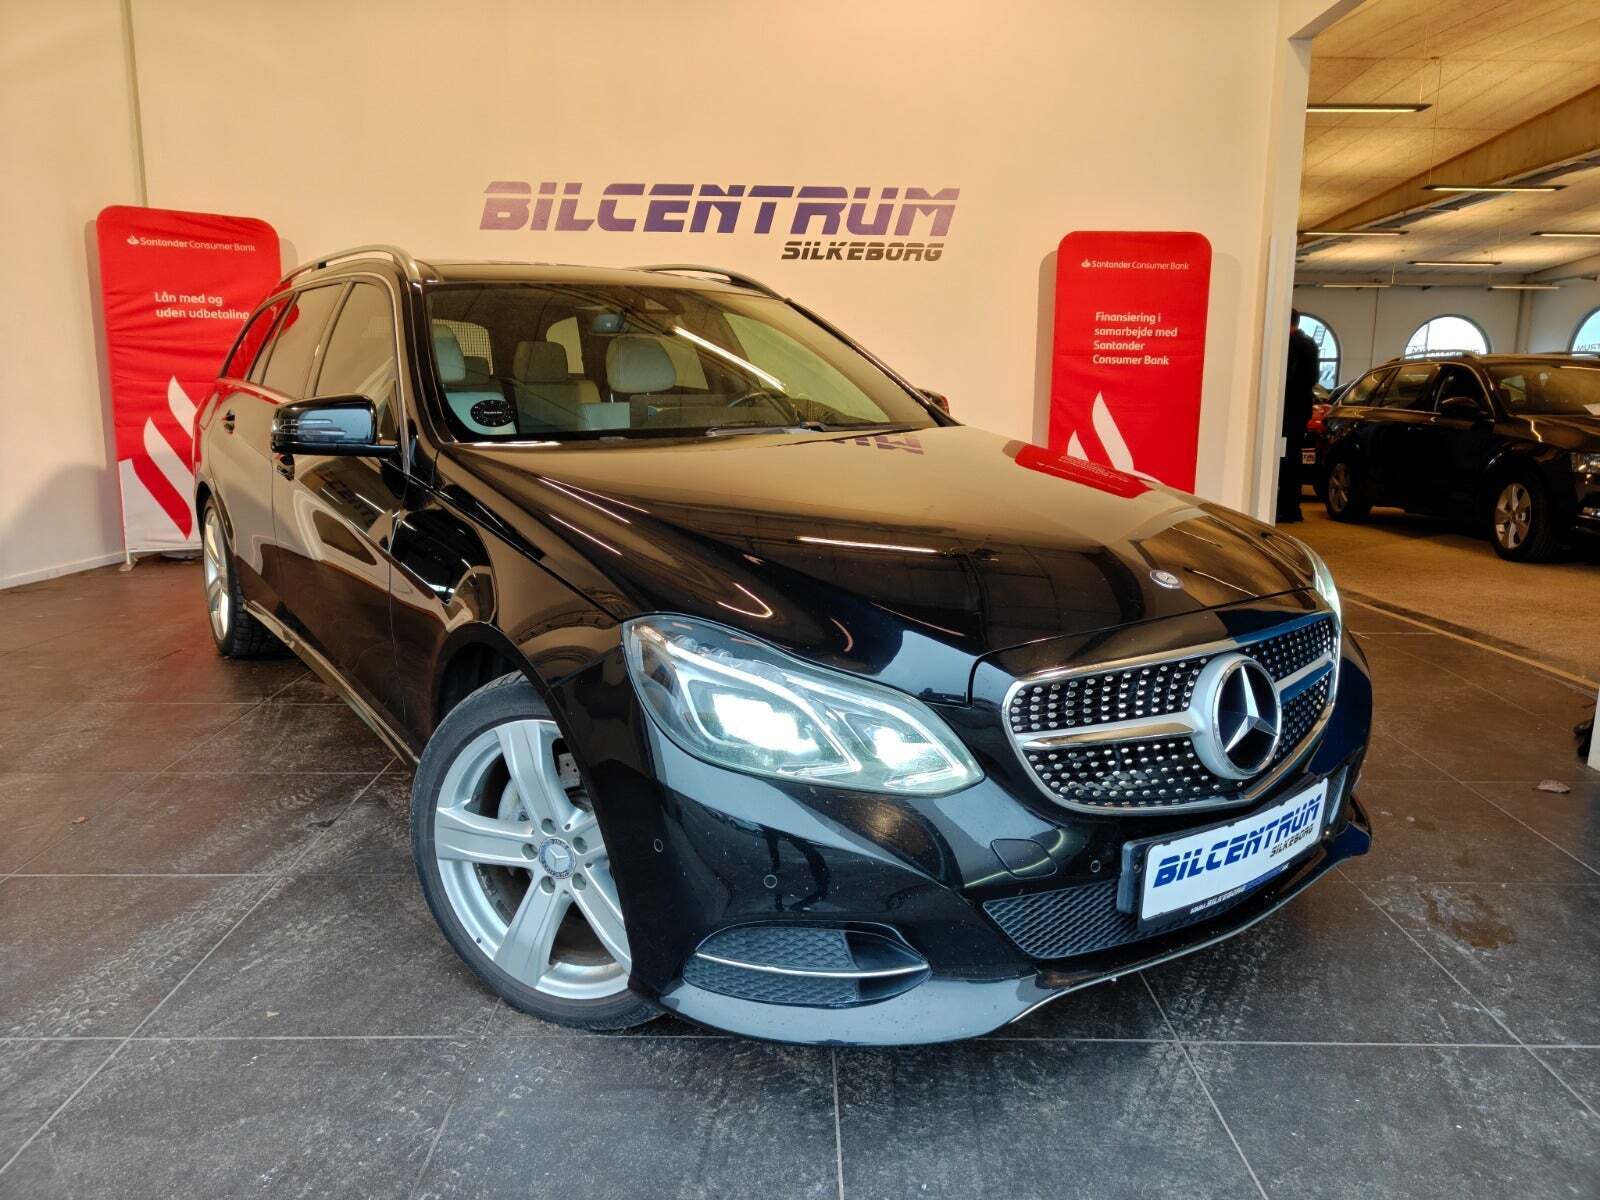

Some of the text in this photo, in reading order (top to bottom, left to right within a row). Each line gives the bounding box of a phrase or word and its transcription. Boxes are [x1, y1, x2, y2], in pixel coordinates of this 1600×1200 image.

[480, 181, 960, 236] BILCENTRUM
[140, 236, 256, 252] Santander Consumer Bank
[781, 240, 945, 262] SILKEBORG
[1091, 260, 1189, 270] Santander Consumer Bank
[154, 292, 223, 306] Lån med og
[155, 308, 186, 318] uden
[1095, 311, 1161, 324] Finansiering i
[1094, 327, 1178, 339] samarbejde med
[1093, 341, 1145, 351] Santander
[1092, 355, 1169, 365] Consumer Bank
[1153, 793, 1323, 888] BILCENTRUM
